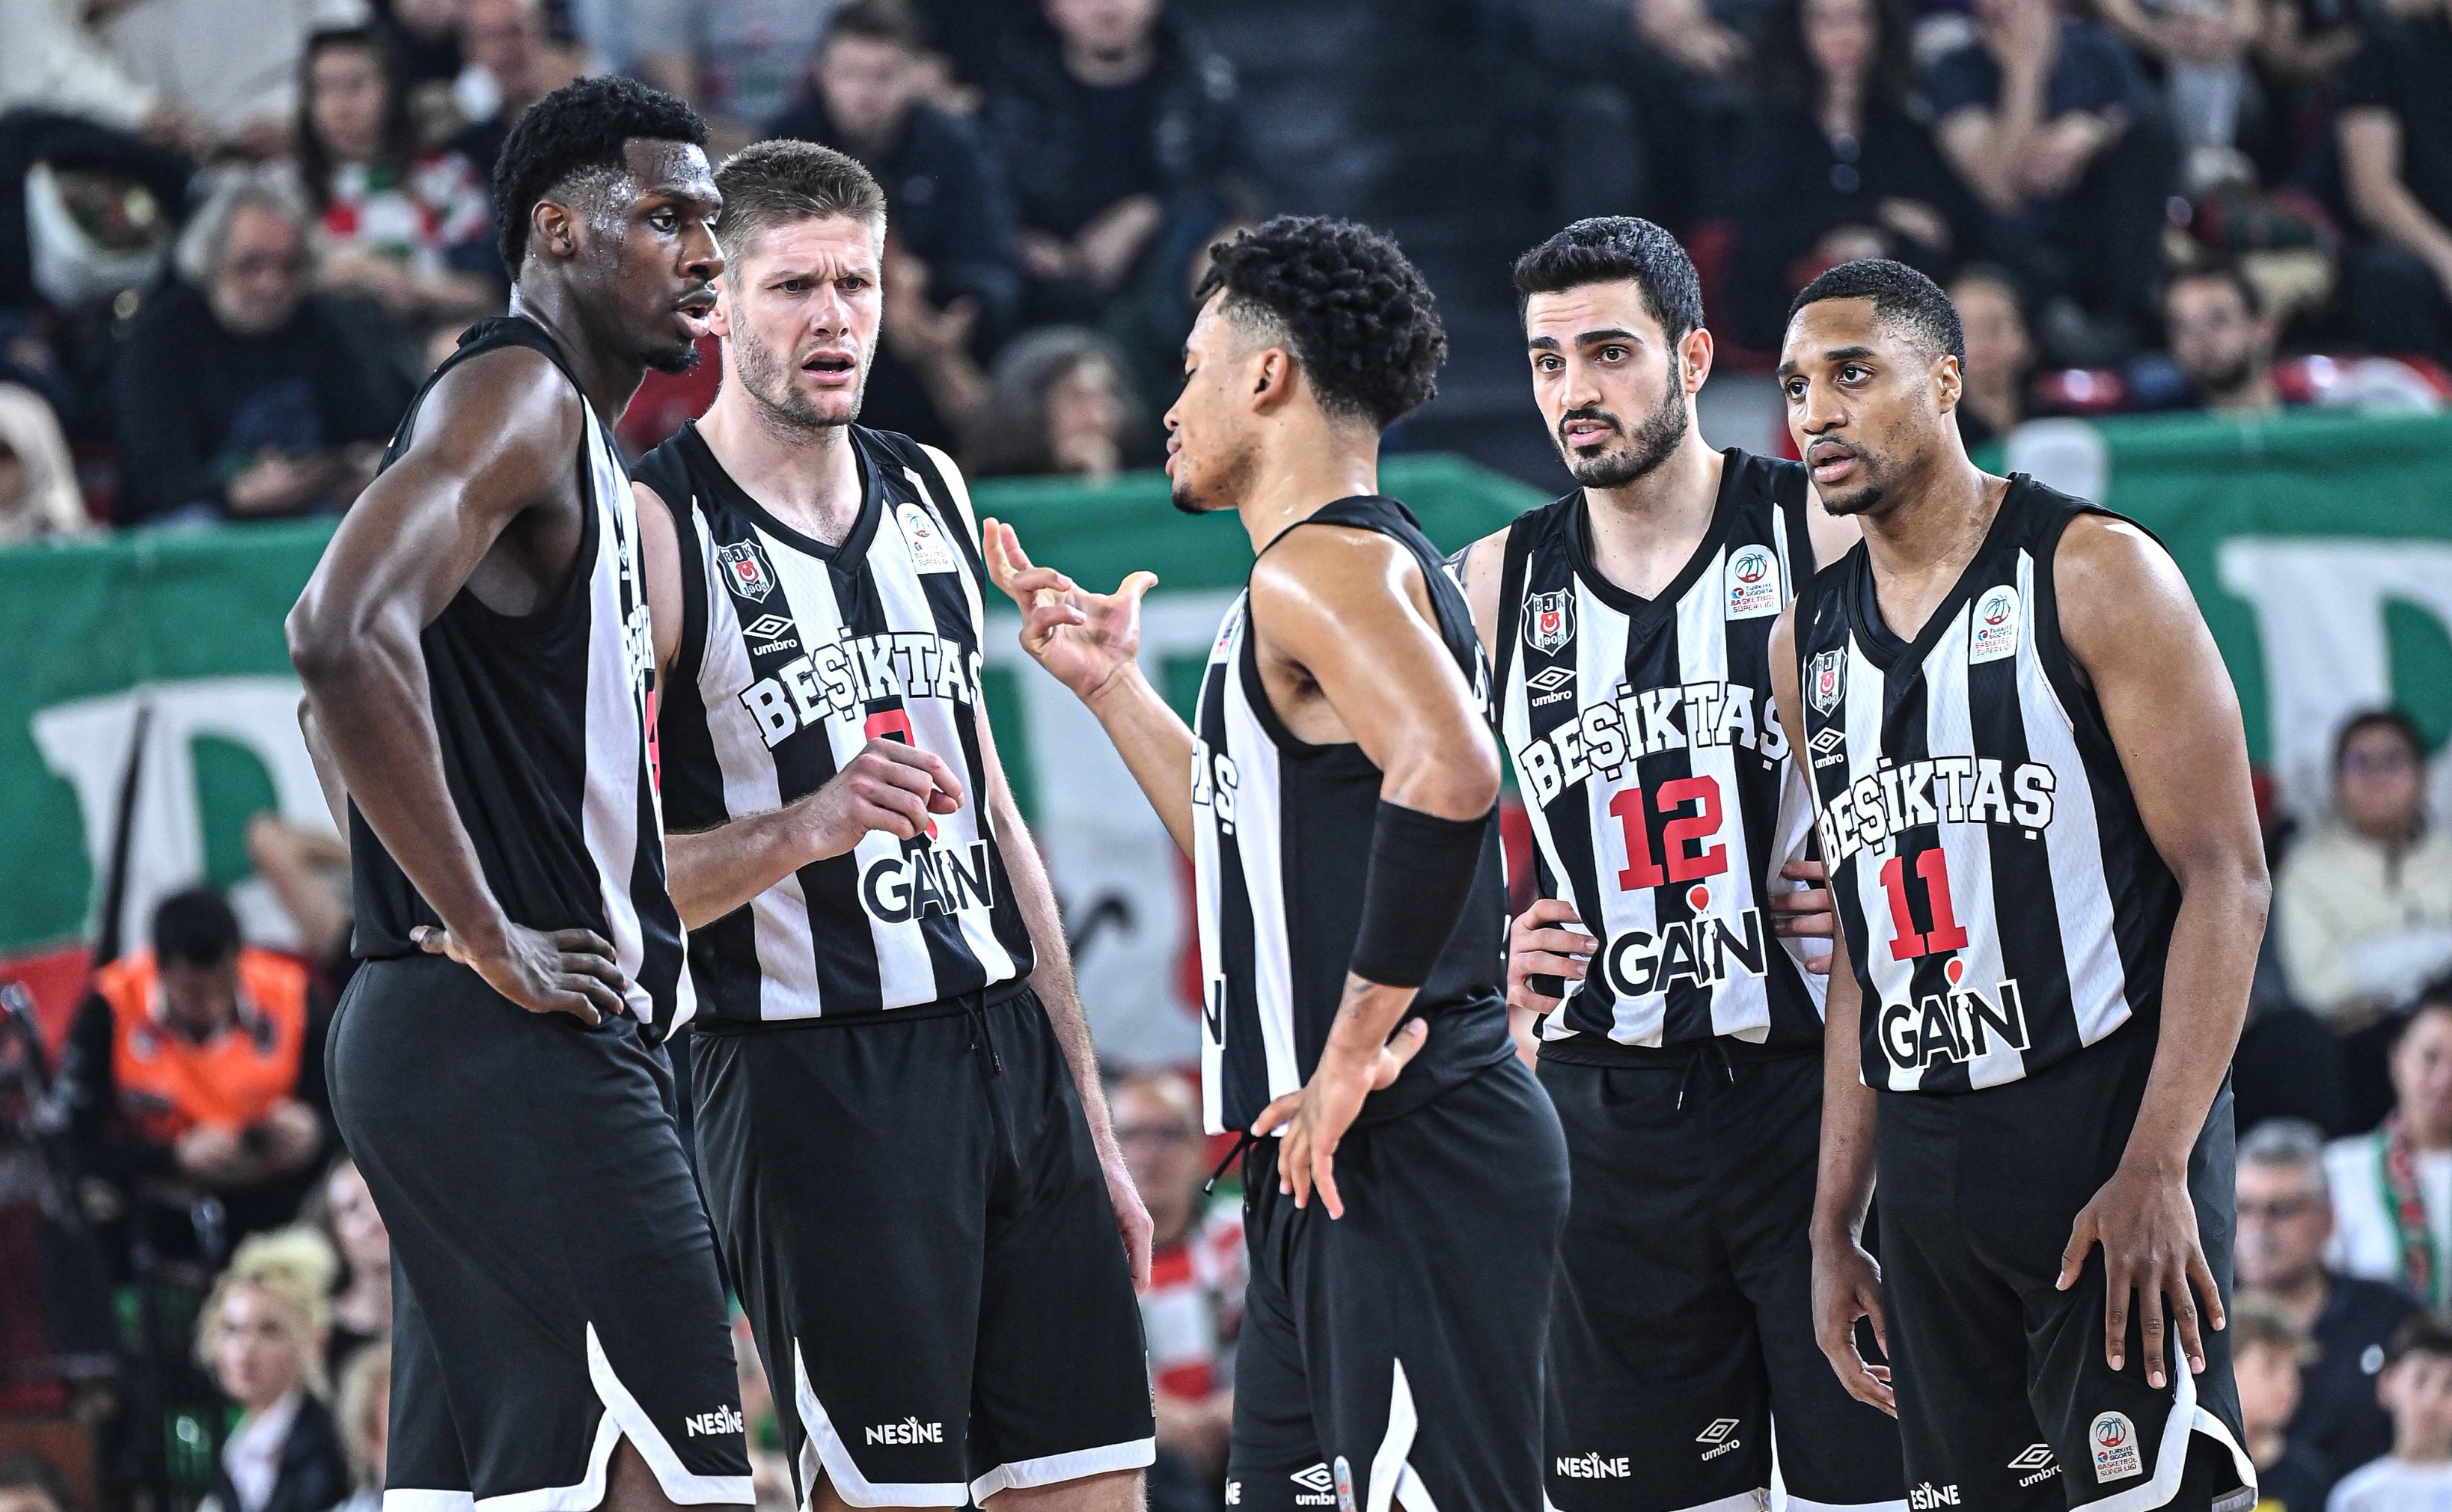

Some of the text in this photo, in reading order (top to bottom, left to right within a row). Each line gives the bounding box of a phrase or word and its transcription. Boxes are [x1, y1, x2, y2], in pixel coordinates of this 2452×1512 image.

[724, 546, 754, 562] BJK
[743, 581, 768, 595] 1903
[1535, 596, 1564, 612] BJK
[753, 638, 798, 656] umbro
[1538, 634, 1565, 646] 1903
[1532, 691, 1572, 707] umbro
[1818, 694, 1838, 708] 1903
[1518, 680, 1790, 810] BEŞİKTAŞ
[1814, 753, 1844, 769] umbro
[1818, 756, 2057, 877] BEŞİKTAŞ
[1609, 774, 1728, 892] 12
[857, 839, 994, 924] GAIN
[1880, 847, 1969, 961] 11
[1605, 907, 1768, 997] GAIN
[1878, 979, 2030, 1071] GAIN
[1702, 1439, 1740, 1461] umbro
